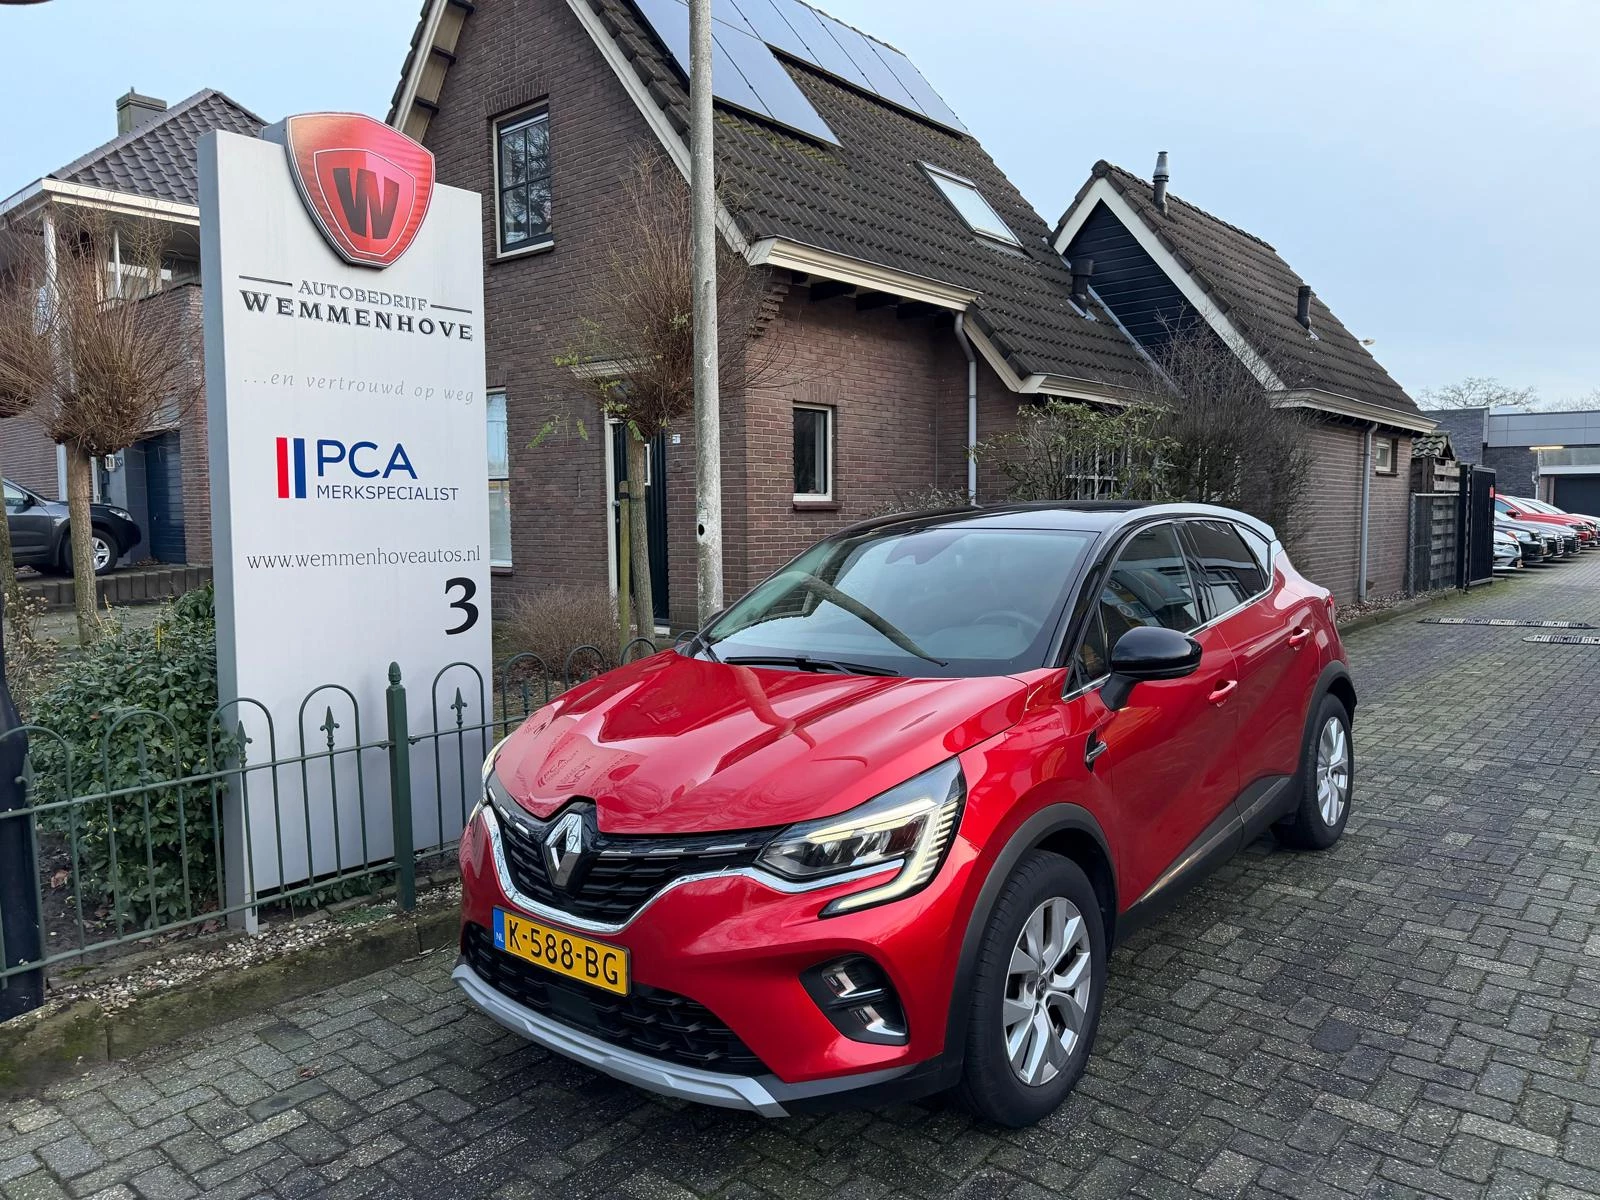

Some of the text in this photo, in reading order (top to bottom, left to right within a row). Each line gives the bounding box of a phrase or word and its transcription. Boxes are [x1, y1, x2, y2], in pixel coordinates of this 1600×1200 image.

[333, 167, 400, 240] W
[239, 289, 473, 342] WEMMENHOVE
[298, 279, 428, 311] AUTOBEDRIJF
[243, 372, 474, 405] ...en vertrouwd op weg
[316, 439, 418, 480] PCA
[316, 484, 459, 501] MERKSPECIALIST
[246, 545, 481, 569] www.wemmenhoveautos.nl
[444, 576, 479, 635] 3
[495, 919, 619, 986] NL K-588-BG
